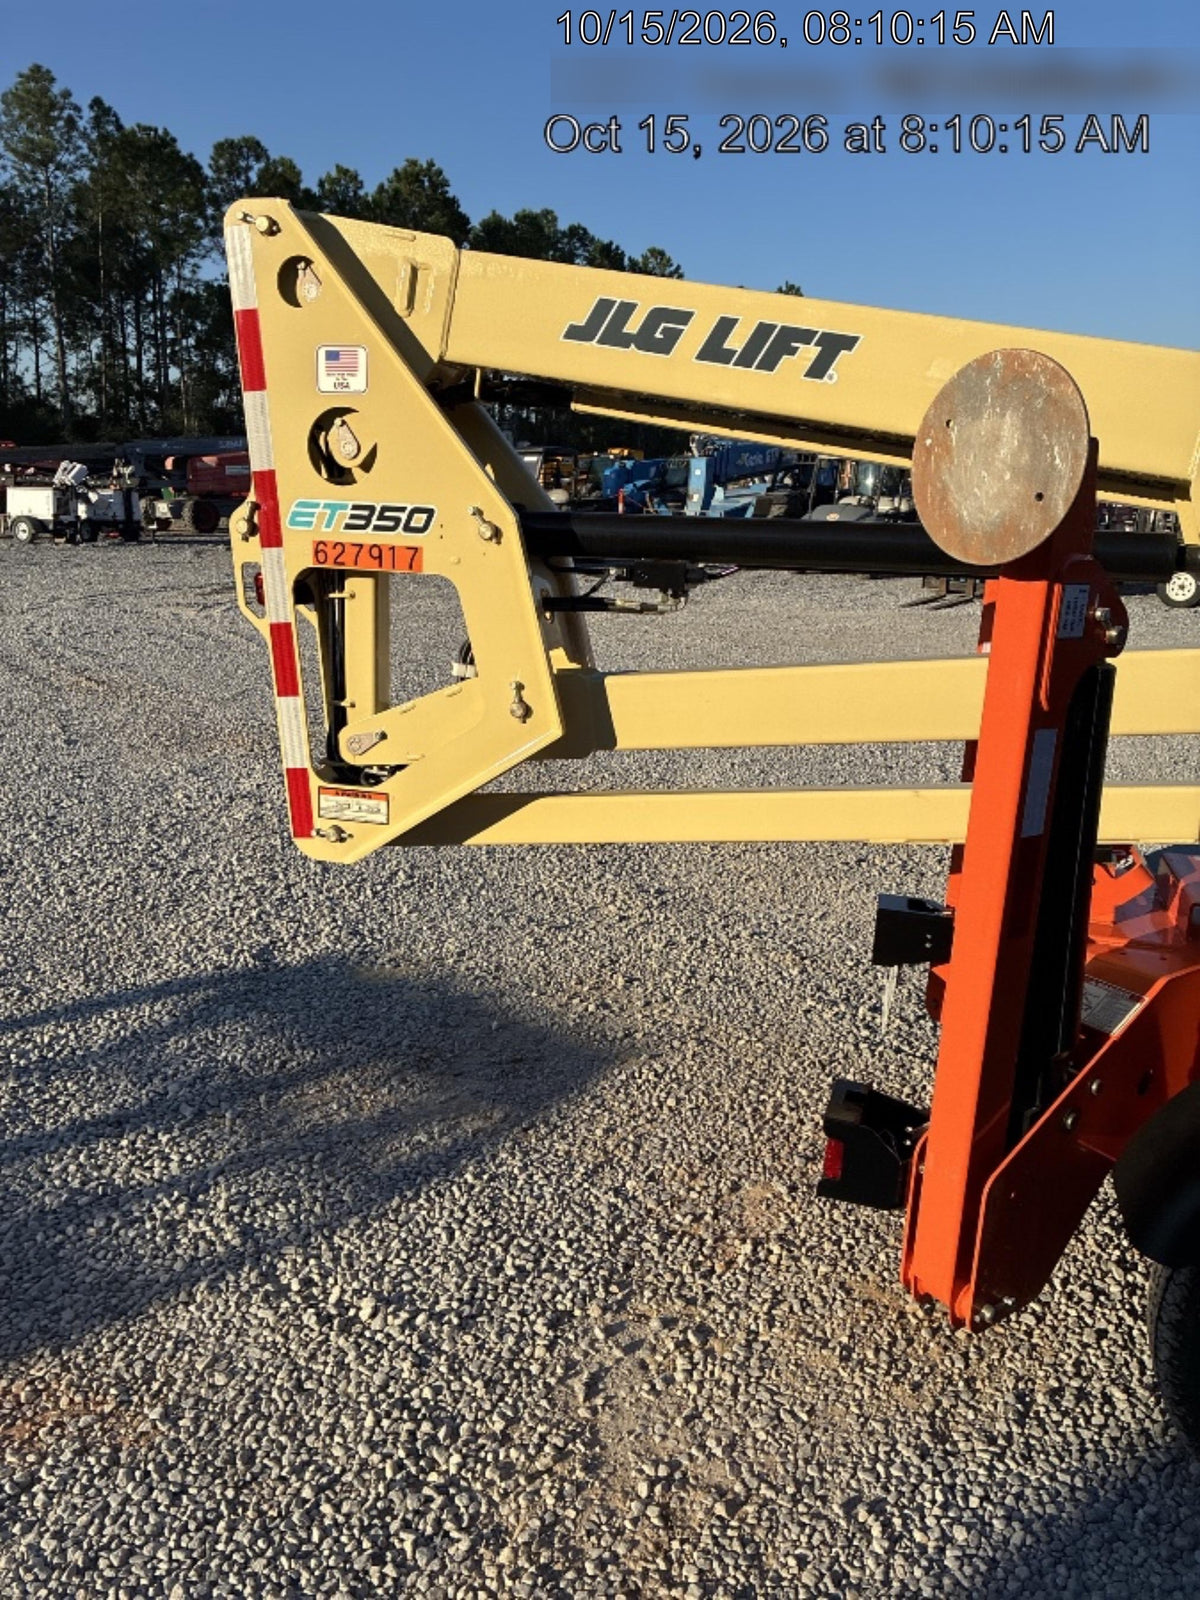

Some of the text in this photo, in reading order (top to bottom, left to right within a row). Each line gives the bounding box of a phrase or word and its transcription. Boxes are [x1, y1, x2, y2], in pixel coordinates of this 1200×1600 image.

[562, 296, 862, 379] JLG LIFT
[287, 499, 437, 535] ET350
[314, 540, 419, 571] 627917
